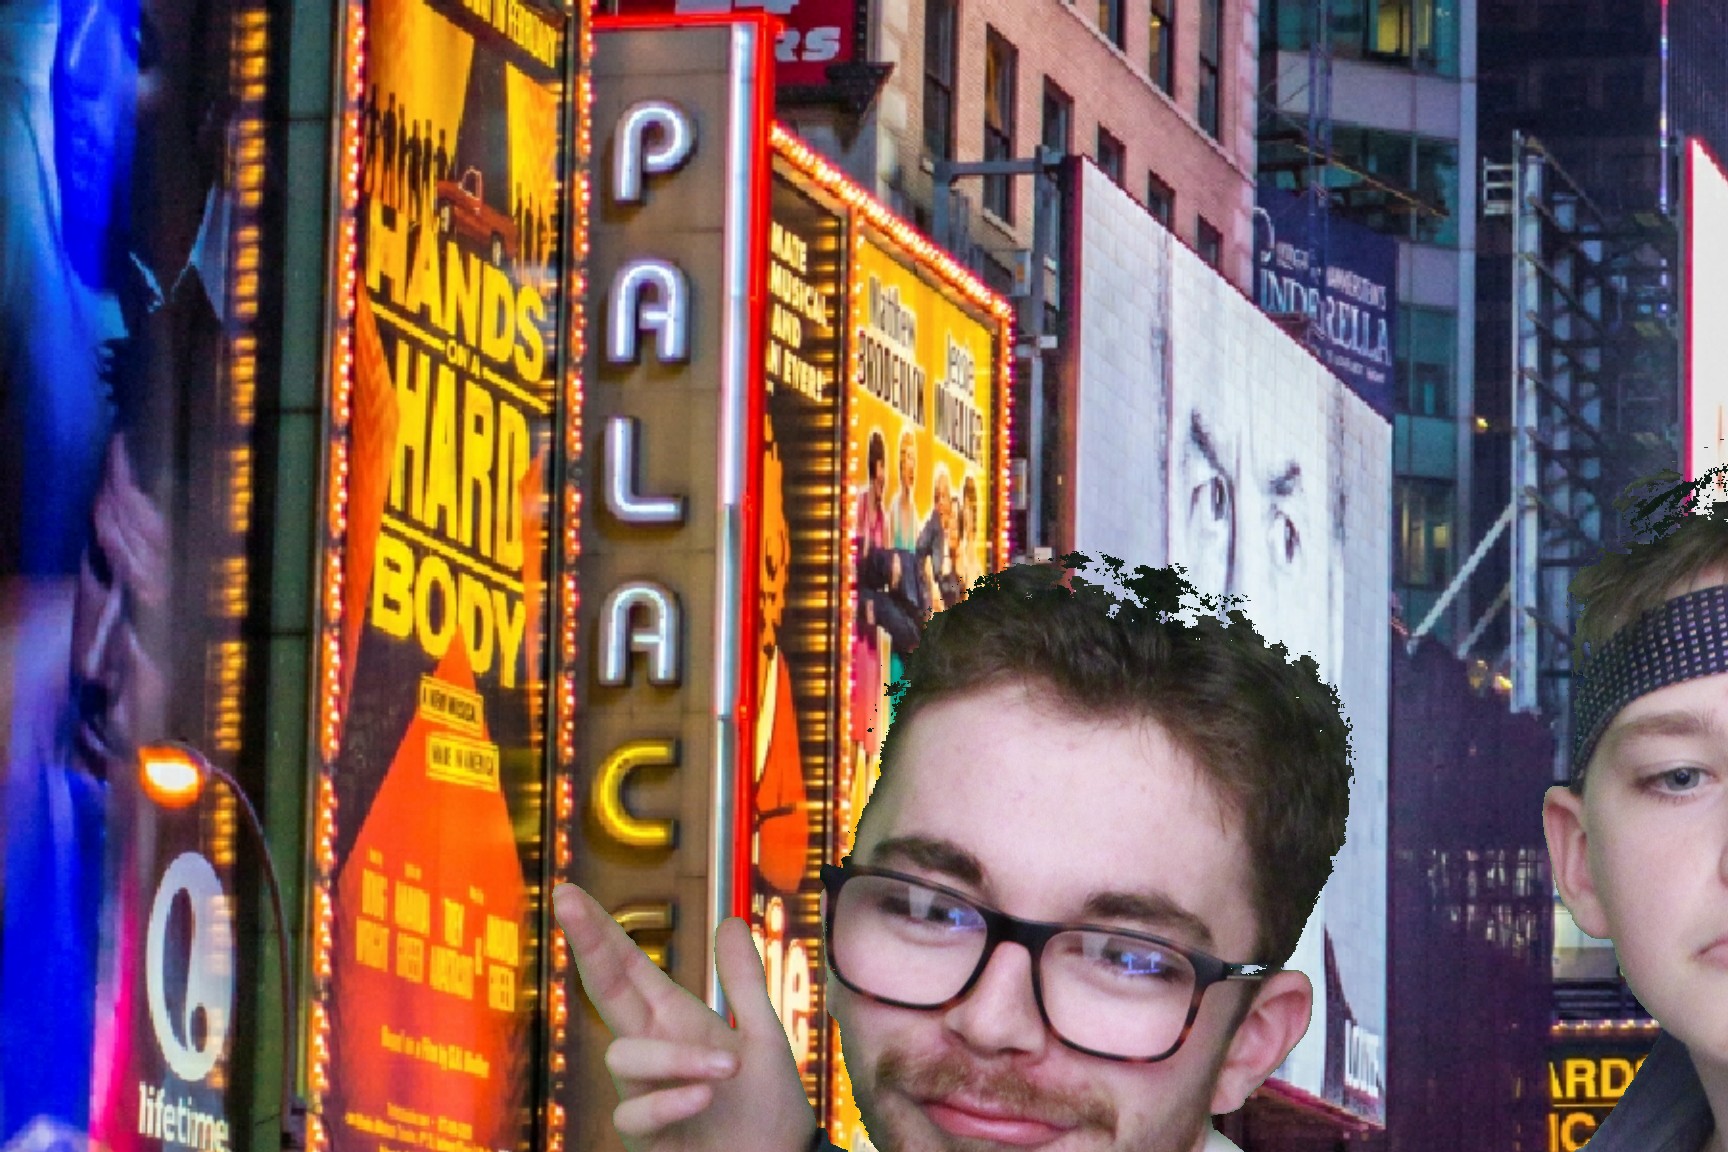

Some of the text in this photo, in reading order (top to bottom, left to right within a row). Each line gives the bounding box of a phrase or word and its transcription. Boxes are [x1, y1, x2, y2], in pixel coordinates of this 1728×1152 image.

[366, 202, 547, 382] HANDS
[390, 340, 531, 572] HARD
[371, 532, 527, 689] BODY
